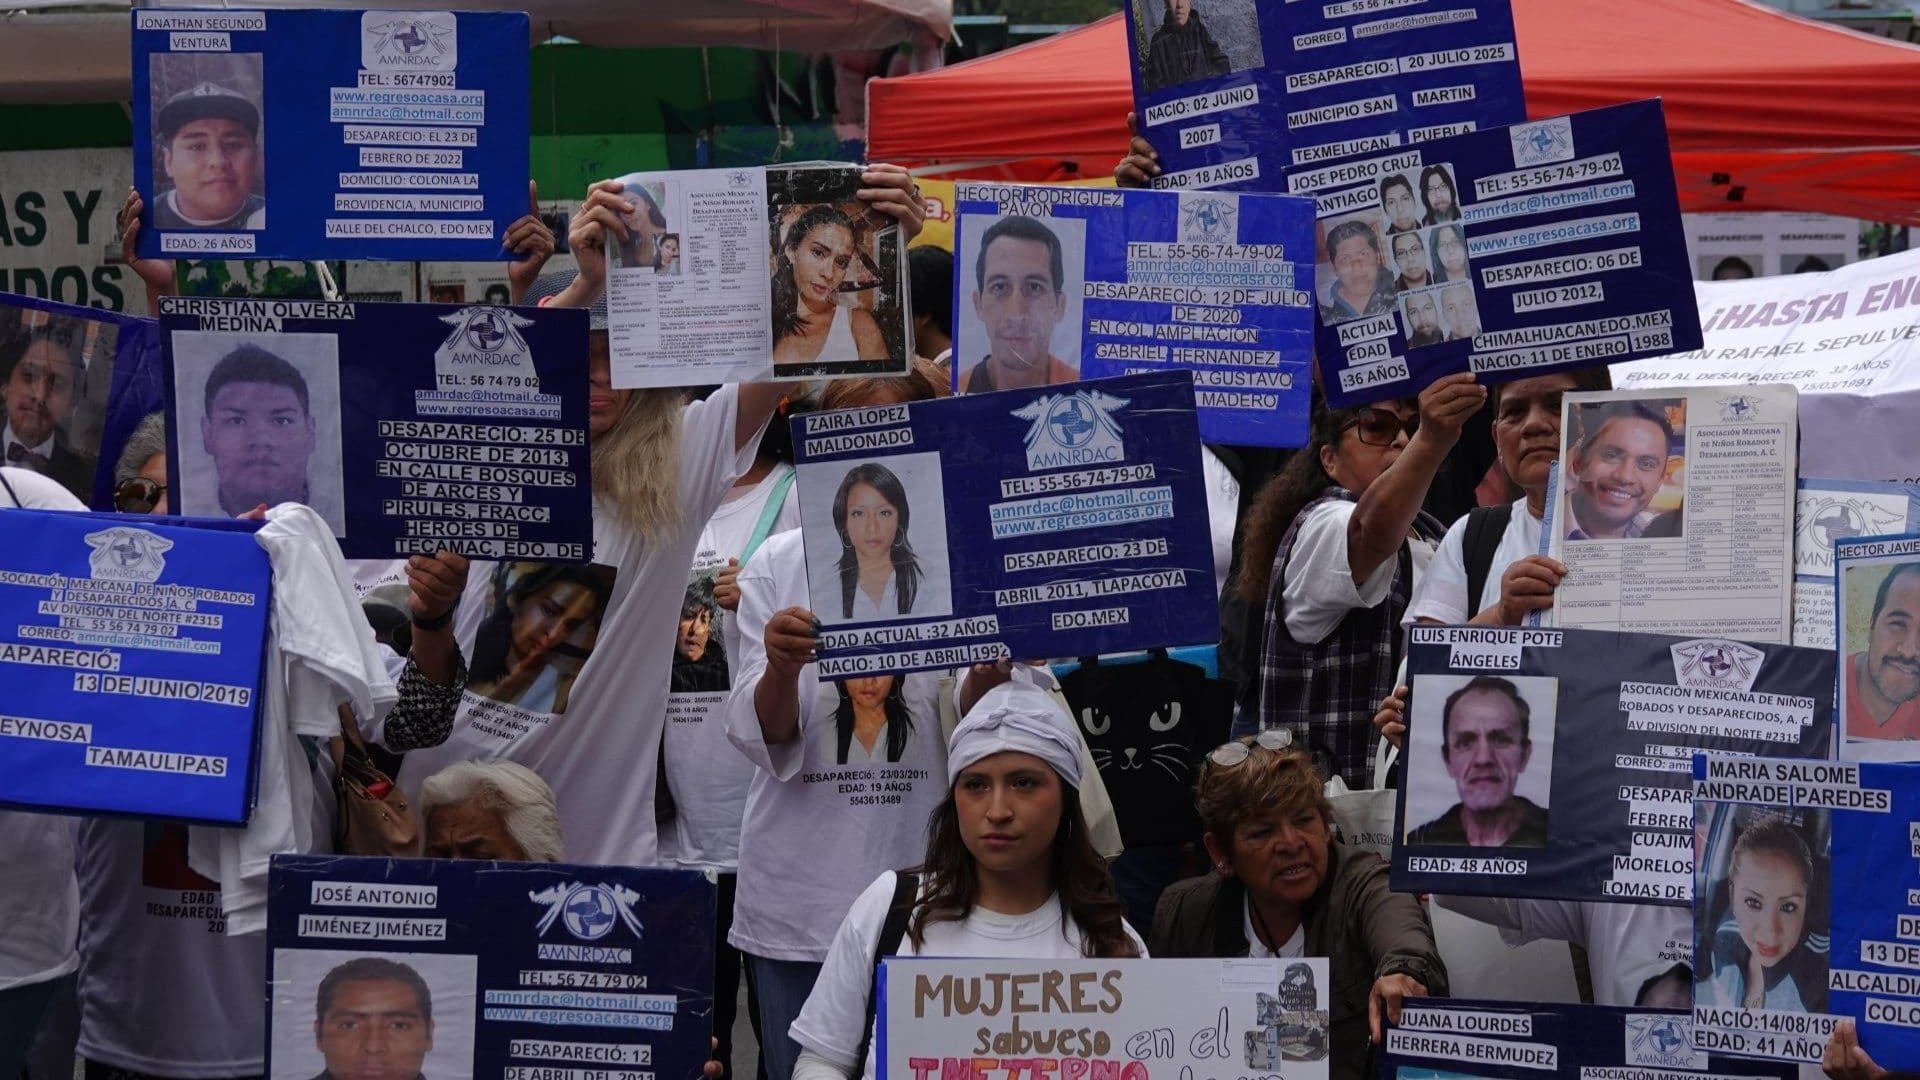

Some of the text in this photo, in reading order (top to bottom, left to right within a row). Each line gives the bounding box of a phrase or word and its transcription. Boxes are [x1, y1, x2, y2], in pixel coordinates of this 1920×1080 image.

[140, 18, 263, 30] JONATHAN SEGUNDO
[1356, 10, 1474, 37] amnrdac@hotmail.com
[173, 38, 228, 49] VENTURA
[1290, 47, 1504, 88] DESAPARECIO: 20 JULIO 2025
[360, 74, 454, 87] TEL: 56747902
[333, 92, 483, 106] www.regresoacasa.org
[1194, 89, 1254, 110] 02 JUNIO
[1289, 87, 1472, 127] MUNICIPIO SAN MARTIN
[332, 106, 483, 121] amnrdac@hotmail.com
[1186, 129, 1215, 144] 2007
[361, 153, 461, 165] FEBRERO DE 2022
[341, 175, 477, 186] DOMICILIO: COLONIA LA
[1293, 154, 1419, 191] JOSE PEDRO CRUZ
[1478, 158, 1620, 194] TEL: 55-56-74-79-02
[336, 199, 482, 212] PROVIDENCIA, MUNICIPIO
[957, 188, 1121, 206] HECTOR RODRIGUEZ
[1464, 181, 1634, 221] amnrdac@hotmail.com
[63, 190, 102, 245] Y
[165, 236, 253, 249] EDAD: 26 AÑOS
[1470, 214, 1636, 255] www.regresoacasa.org
[1129, 246, 1282, 259] TEL: 55-56-74-79-02
[1127, 260, 1293, 274] amnrdac@hotmail.com
[1485, 250, 1639, 284] DESAPARECIO: 06 DE
[1128, 273, 1293, 287] www.regresoacasa.org
[1516, 284, 1601, 309] JULIO 2012,
[161, 300, 354, 319] CHRISTIAN OLVERA
[1175, 309, 1240, 323] DE 2020
[1702, 291, 1848, 332] ¡HASTA
[1340, 319, 1394, 340] ACTUAL
[1474, 312, 1669, 350] CHIMALHUACAN EDO.MEX
[452, 352, 521, 366] AMNRDAC
[1096, 345, 1165, 360] GABRIEL
[1349, 344, 1386, 361] EDAD
[1717, 342, 1806, 360] RAFAEL
[1210, 373, 1291, 387] GUSTAVO
[1203, 393, 1276, 408] MADERO
[809, 407, 905, 432] ZAIRA LOPEZ
[808, 428, 911, 454] MALDONADO
[386, 443, 482, 460] OCTUBRE
[488, 445, 514, 463] DE
[1033, 448, 1117, 467] AMNRDAC
[377, 462, 575, 486] EN CALLE BOSQUES
[1003, 466, 1152, 495] TEL: 55-56-74-79-02
[402, 482, 520, 502] DE ARCES Y
[384, 502, 550, 523] PIRULES, FRACC.
[992, 486, 1171, 520] amnrdac@hotmail.com
[406, 522, 518, 537] HEROES DE
[994, 503, 1170, 536] www.regresoacasa.org
[1839, 545, 1884, 558] HECTOR
[70, 580, 254, 604] MEXICANA DE NIÑOS ROBADOS
[998, 572, 1185, 604] ABRIL 2011, TLAPACOYA
[1053, 609, 1127, 629] EDO.MEX
[1413, 629, 1561, 647] LUIS ENRIQUE POTE
[1450, 649, 1519, 668] ÁNGELES
[76, 674, 249, 705] 13 DE JUNIO 2019
[1621, 682, 1813, 708] ASOCIACIÓN MEXICANA DE NIÑOS
[89, 748, 224, 775] TAMAULIPAS
[1710, 761, 1856, 784] MARIA SALOME
[838, 780, 912, 793] EDAD: 19 AÑOS
[1696, 782, 1887, 808] ANDRADE PAREDES
[1409, 856, 1525, 873] EDAD: 48 AÑOS
[181, 892, 214, 904] EDAD
[315, 885, 436, 906] JOSÉ ANTONIO
[302, 918, 443, 938] JIMÉNEZ JIMÉNEZ
[538, 945, 629, 963] AMNRDAC
[486, 991, 676, 1012] amnrdac@hotmail.com
[914, 970, 1122, 1017] MUJERES
[485, 1008, 671, 1029] www.regresoacasa.org
[1401, 1010, 1529, 1033] JUANA LOURDES
[973, 1017, 1111, 1057] sabueso
[1126, 1007, 1231, 1060] en el
[1695, 1031, 1774, 1053] EDAD: 41
[511, 1040, 649, 1063] DESAPARECIÓ: 12
[1391, 1036, 1553, 1065] HERRERA BERMUDEZ
[1636, 1054, 1694, 1066] AMNRDAC
